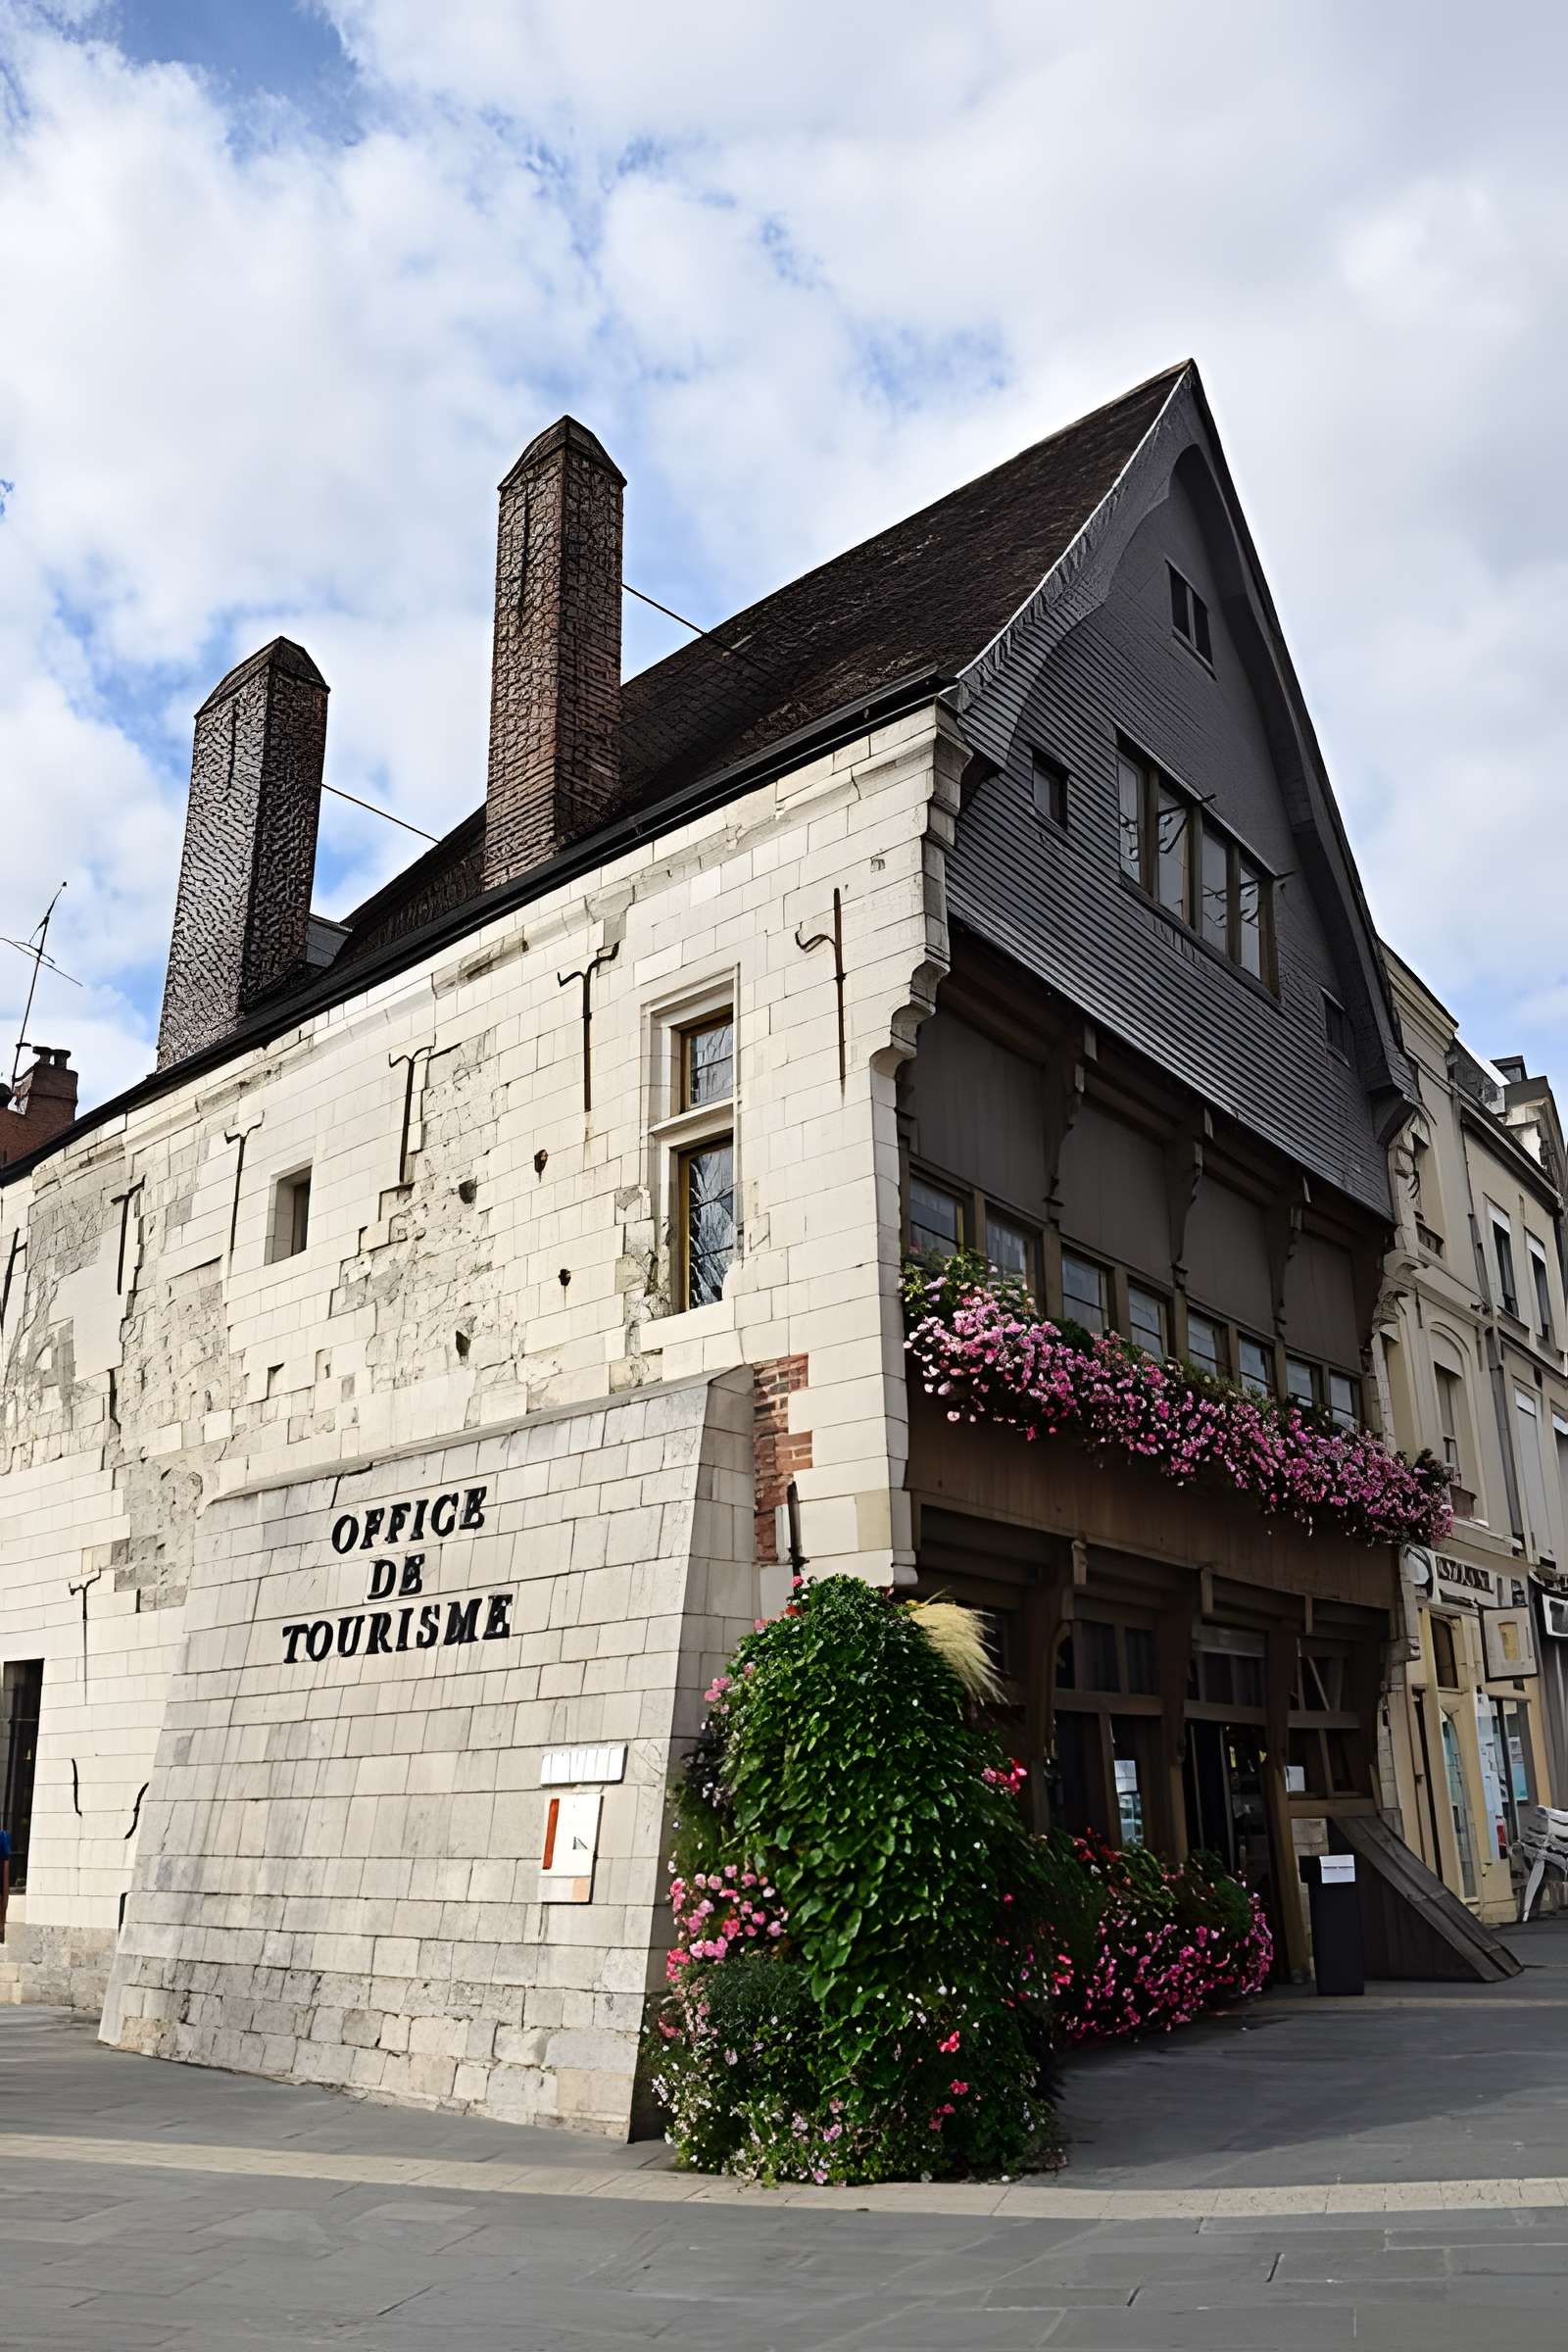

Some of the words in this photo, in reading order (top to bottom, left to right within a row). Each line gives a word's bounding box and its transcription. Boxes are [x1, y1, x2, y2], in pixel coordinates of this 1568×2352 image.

[332, 1487, 487, 1554] OFFICE
[367, 1554, 424, 1599] DE
[282, 1594, 513, 1663] TOURISME
